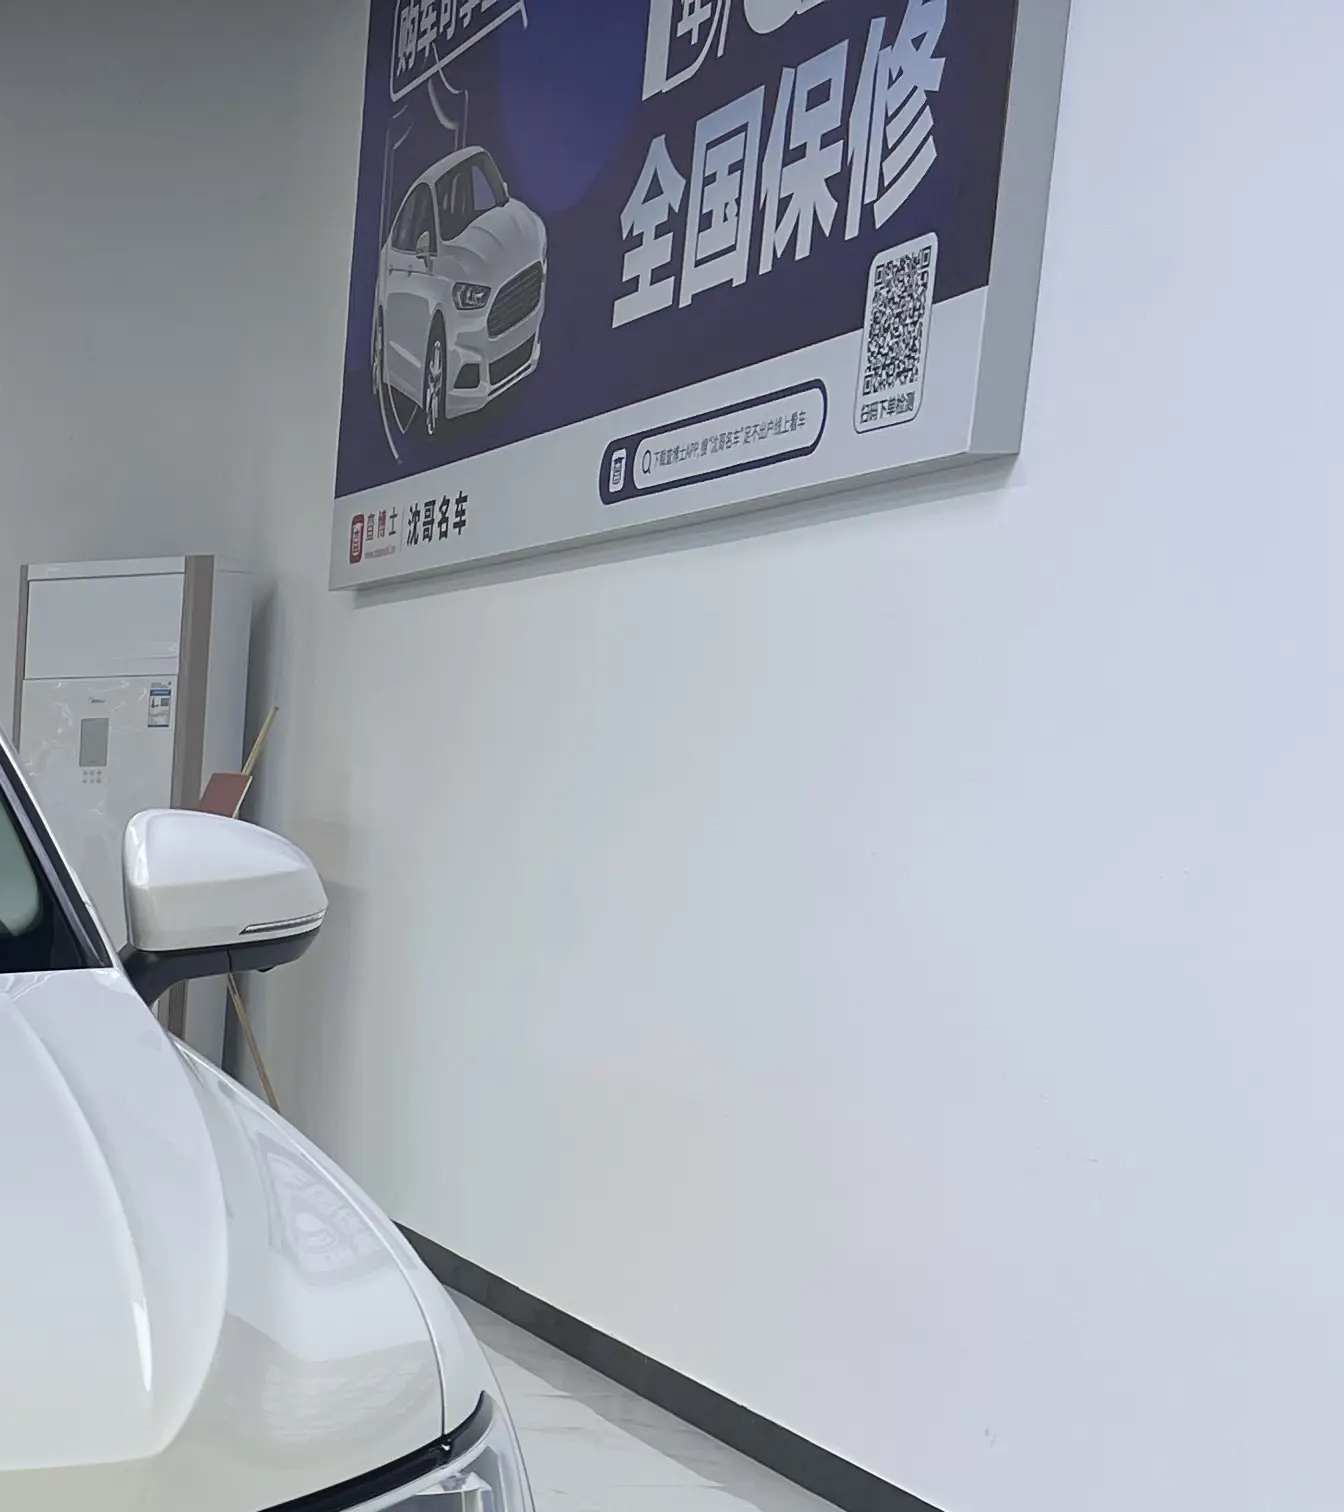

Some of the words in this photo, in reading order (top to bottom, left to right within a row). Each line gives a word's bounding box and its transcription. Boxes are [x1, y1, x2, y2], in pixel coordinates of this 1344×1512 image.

[612, 0, 948, 328] 全国保修
[407, 490, 468, 546] 沈哥名车
